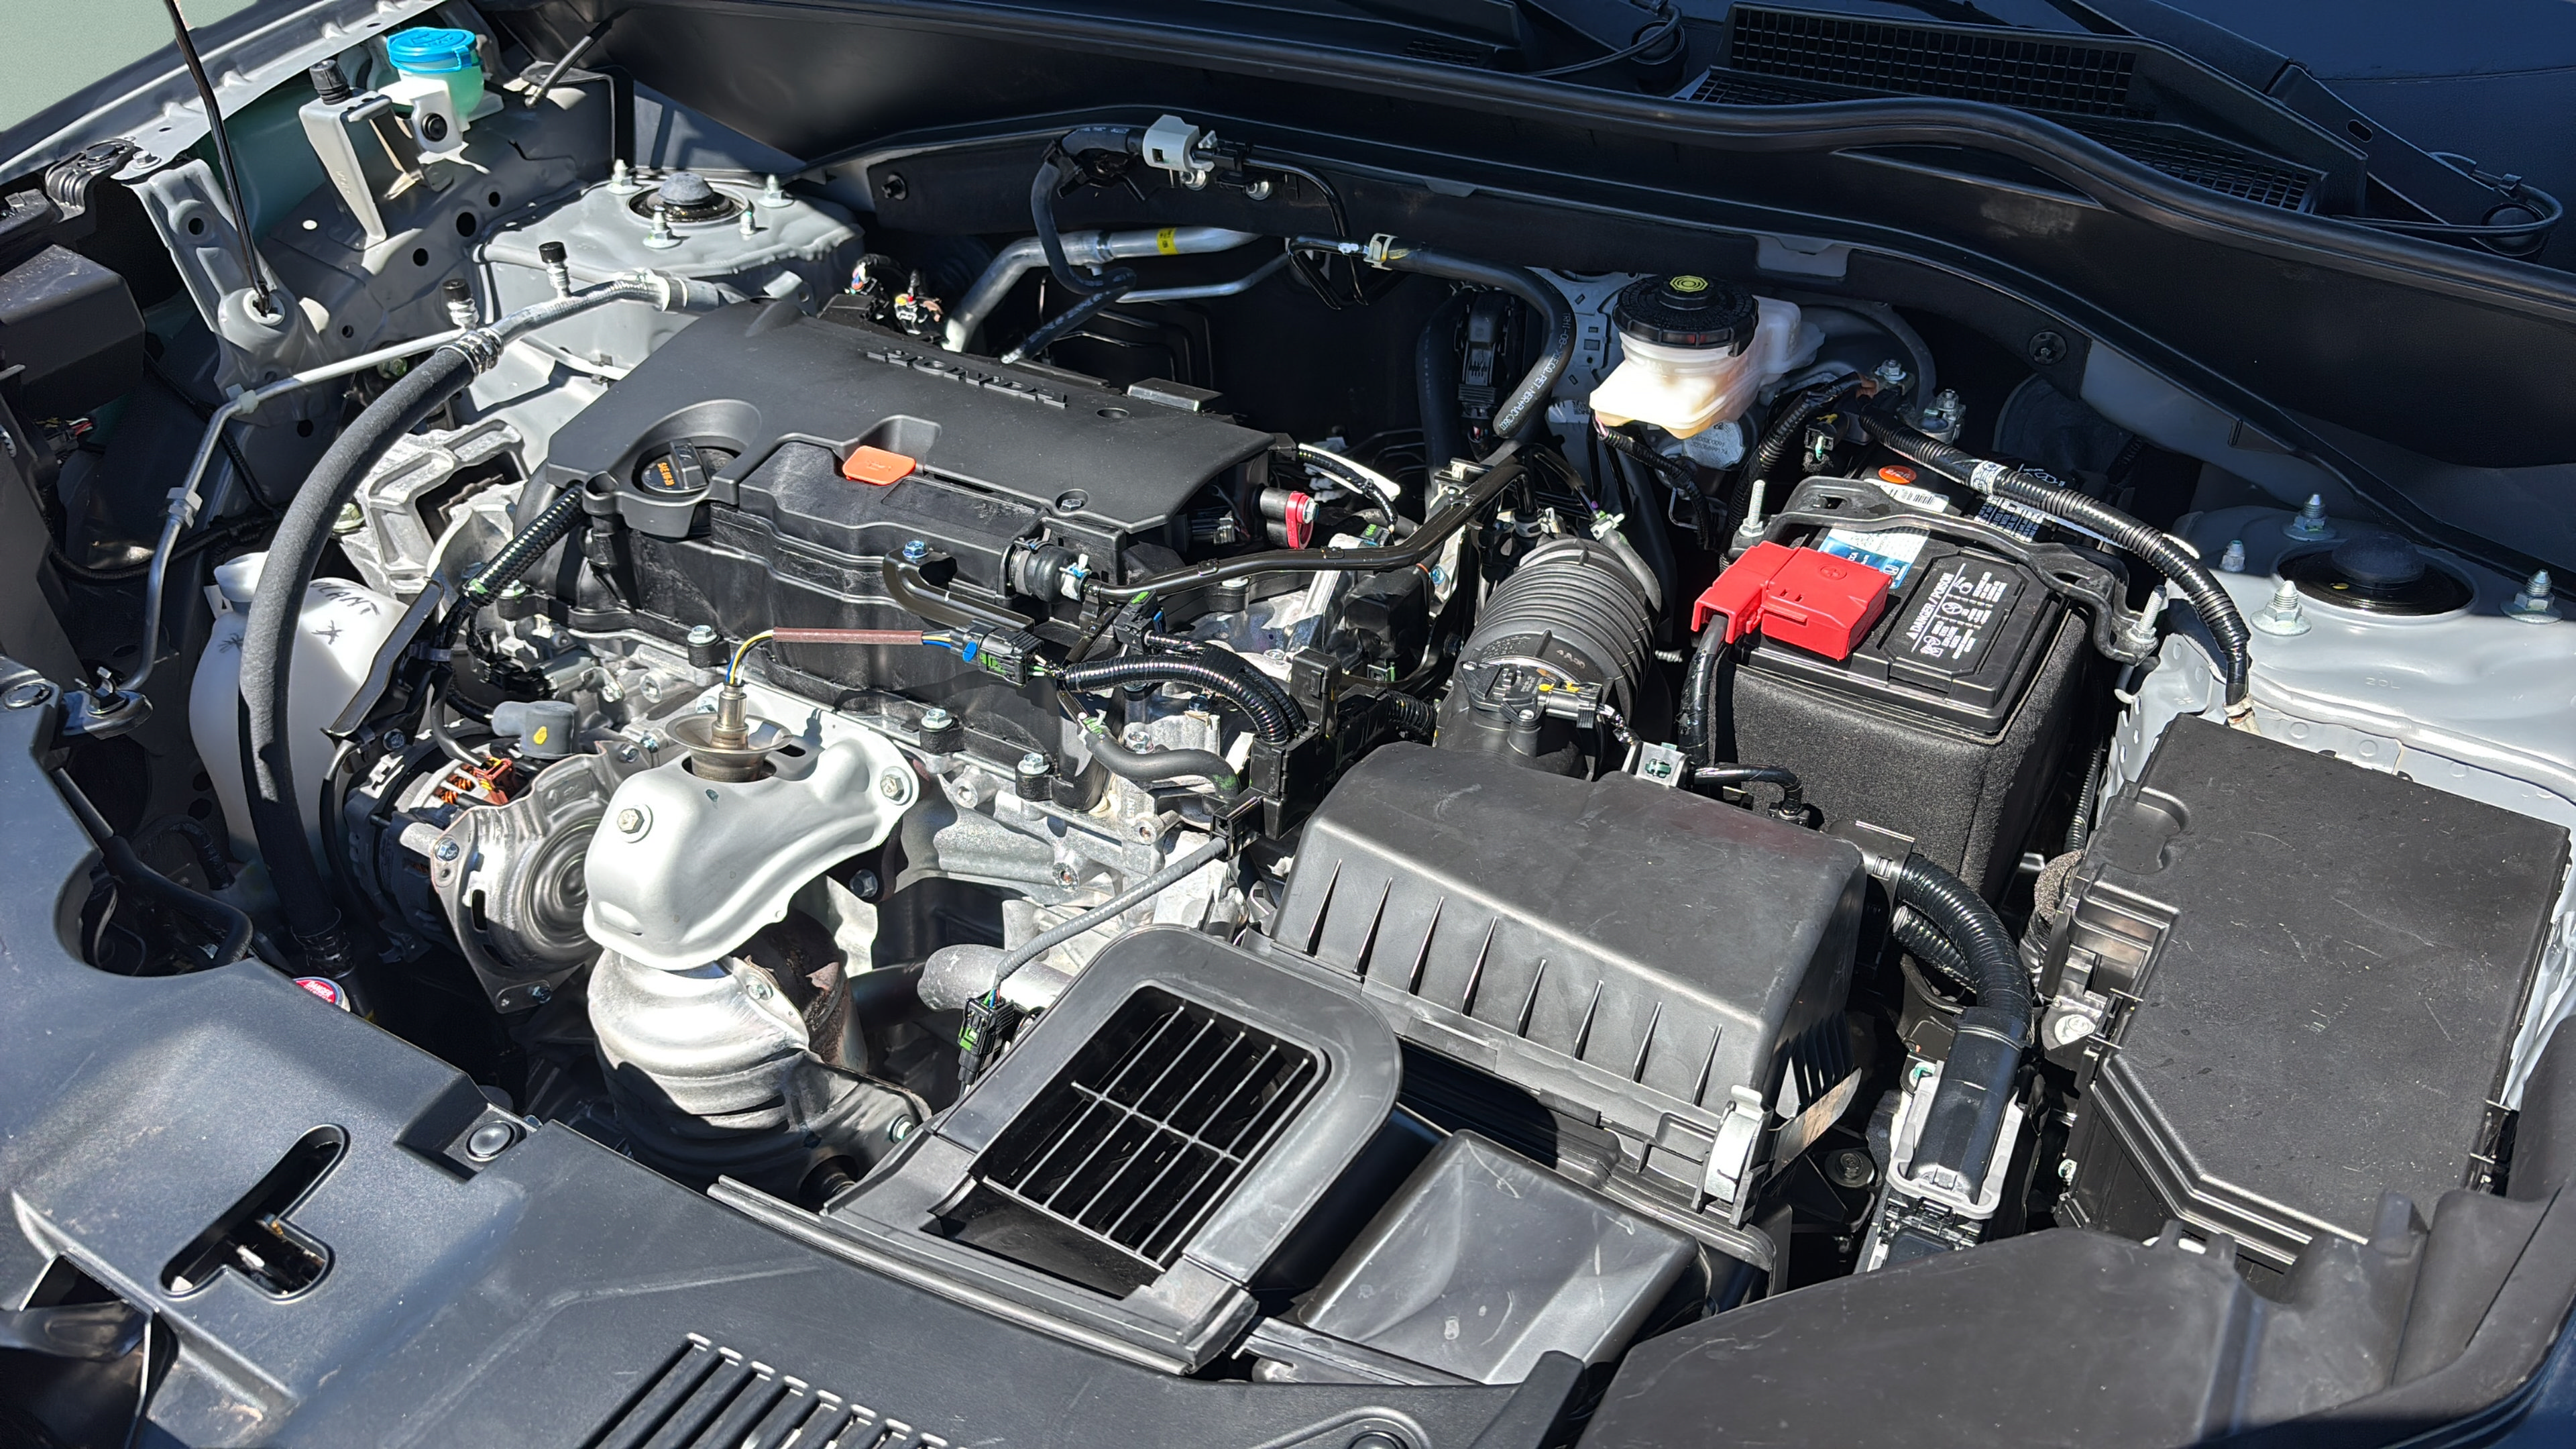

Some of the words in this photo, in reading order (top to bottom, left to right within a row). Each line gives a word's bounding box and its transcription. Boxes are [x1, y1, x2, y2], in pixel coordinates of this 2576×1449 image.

[657, 463, 669, 472] SAE
[1909, 602, 1935, 632] DANGER
[1931, 572, 1954, 598] POISON
[306, 980, 333, 999] DANGER
